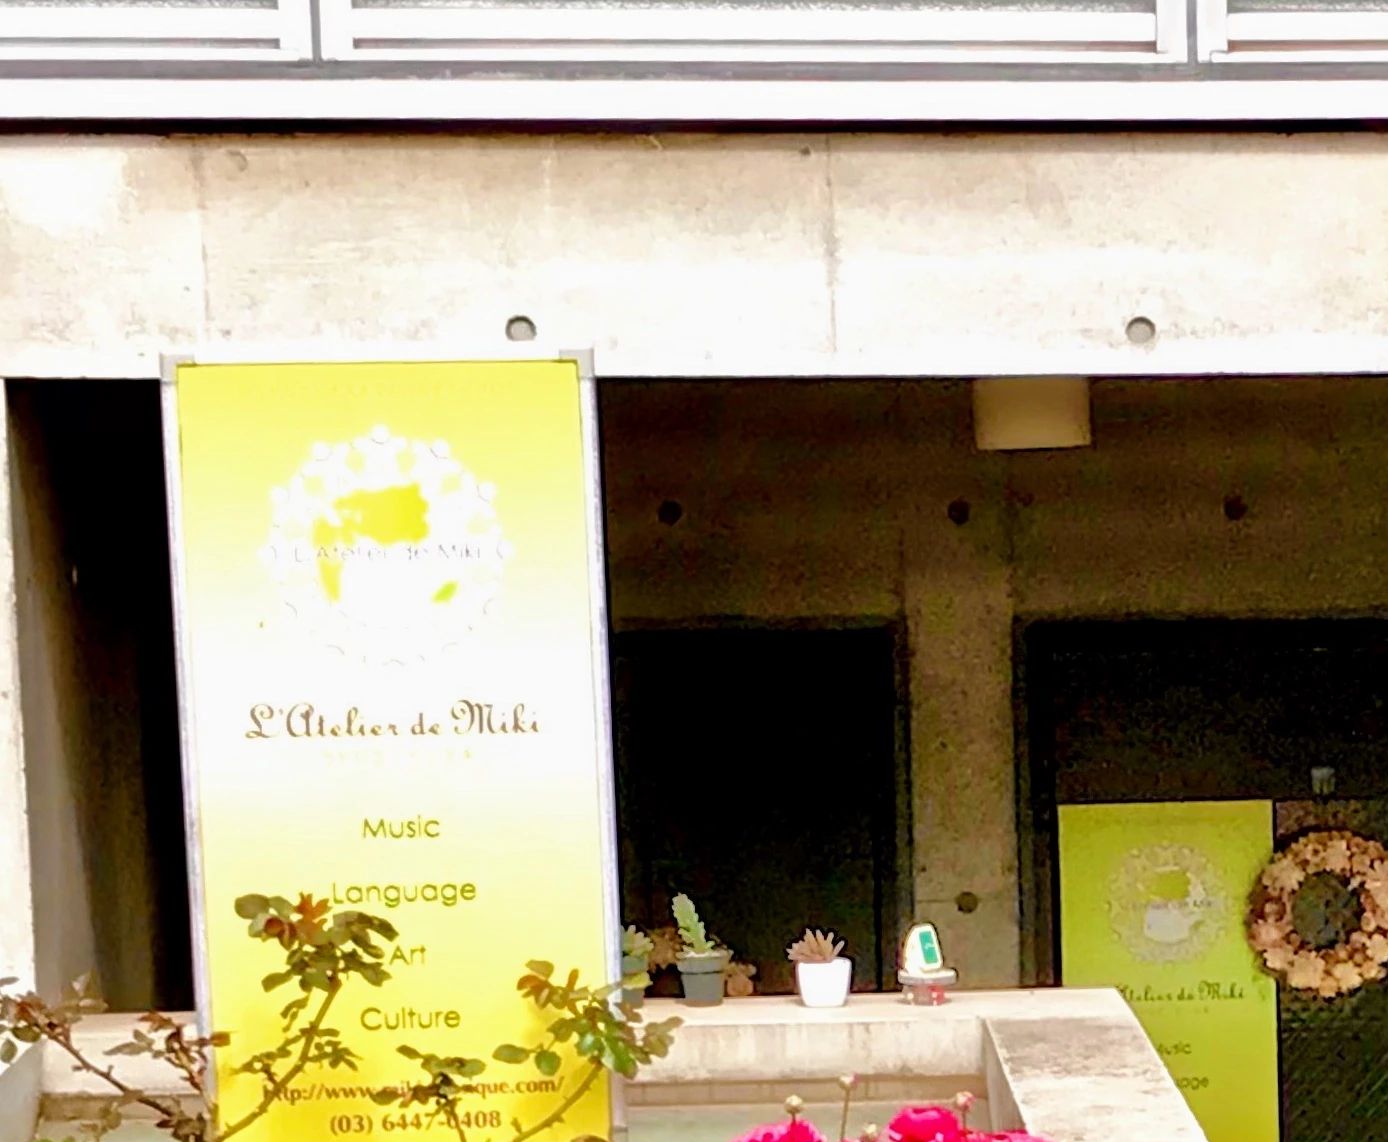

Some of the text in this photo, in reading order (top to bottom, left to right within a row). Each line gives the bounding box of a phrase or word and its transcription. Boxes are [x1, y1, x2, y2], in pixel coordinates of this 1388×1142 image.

[245, 699, 539, 739] L'Atelier de Miki
[363, 815, 441, 839] Music
[332, 882, 477, 908] Language
[388, 944, 427, 966] Art
[360, 1006, 461, 1031] Culture
[330, 1114, 373, 1135] (03)
